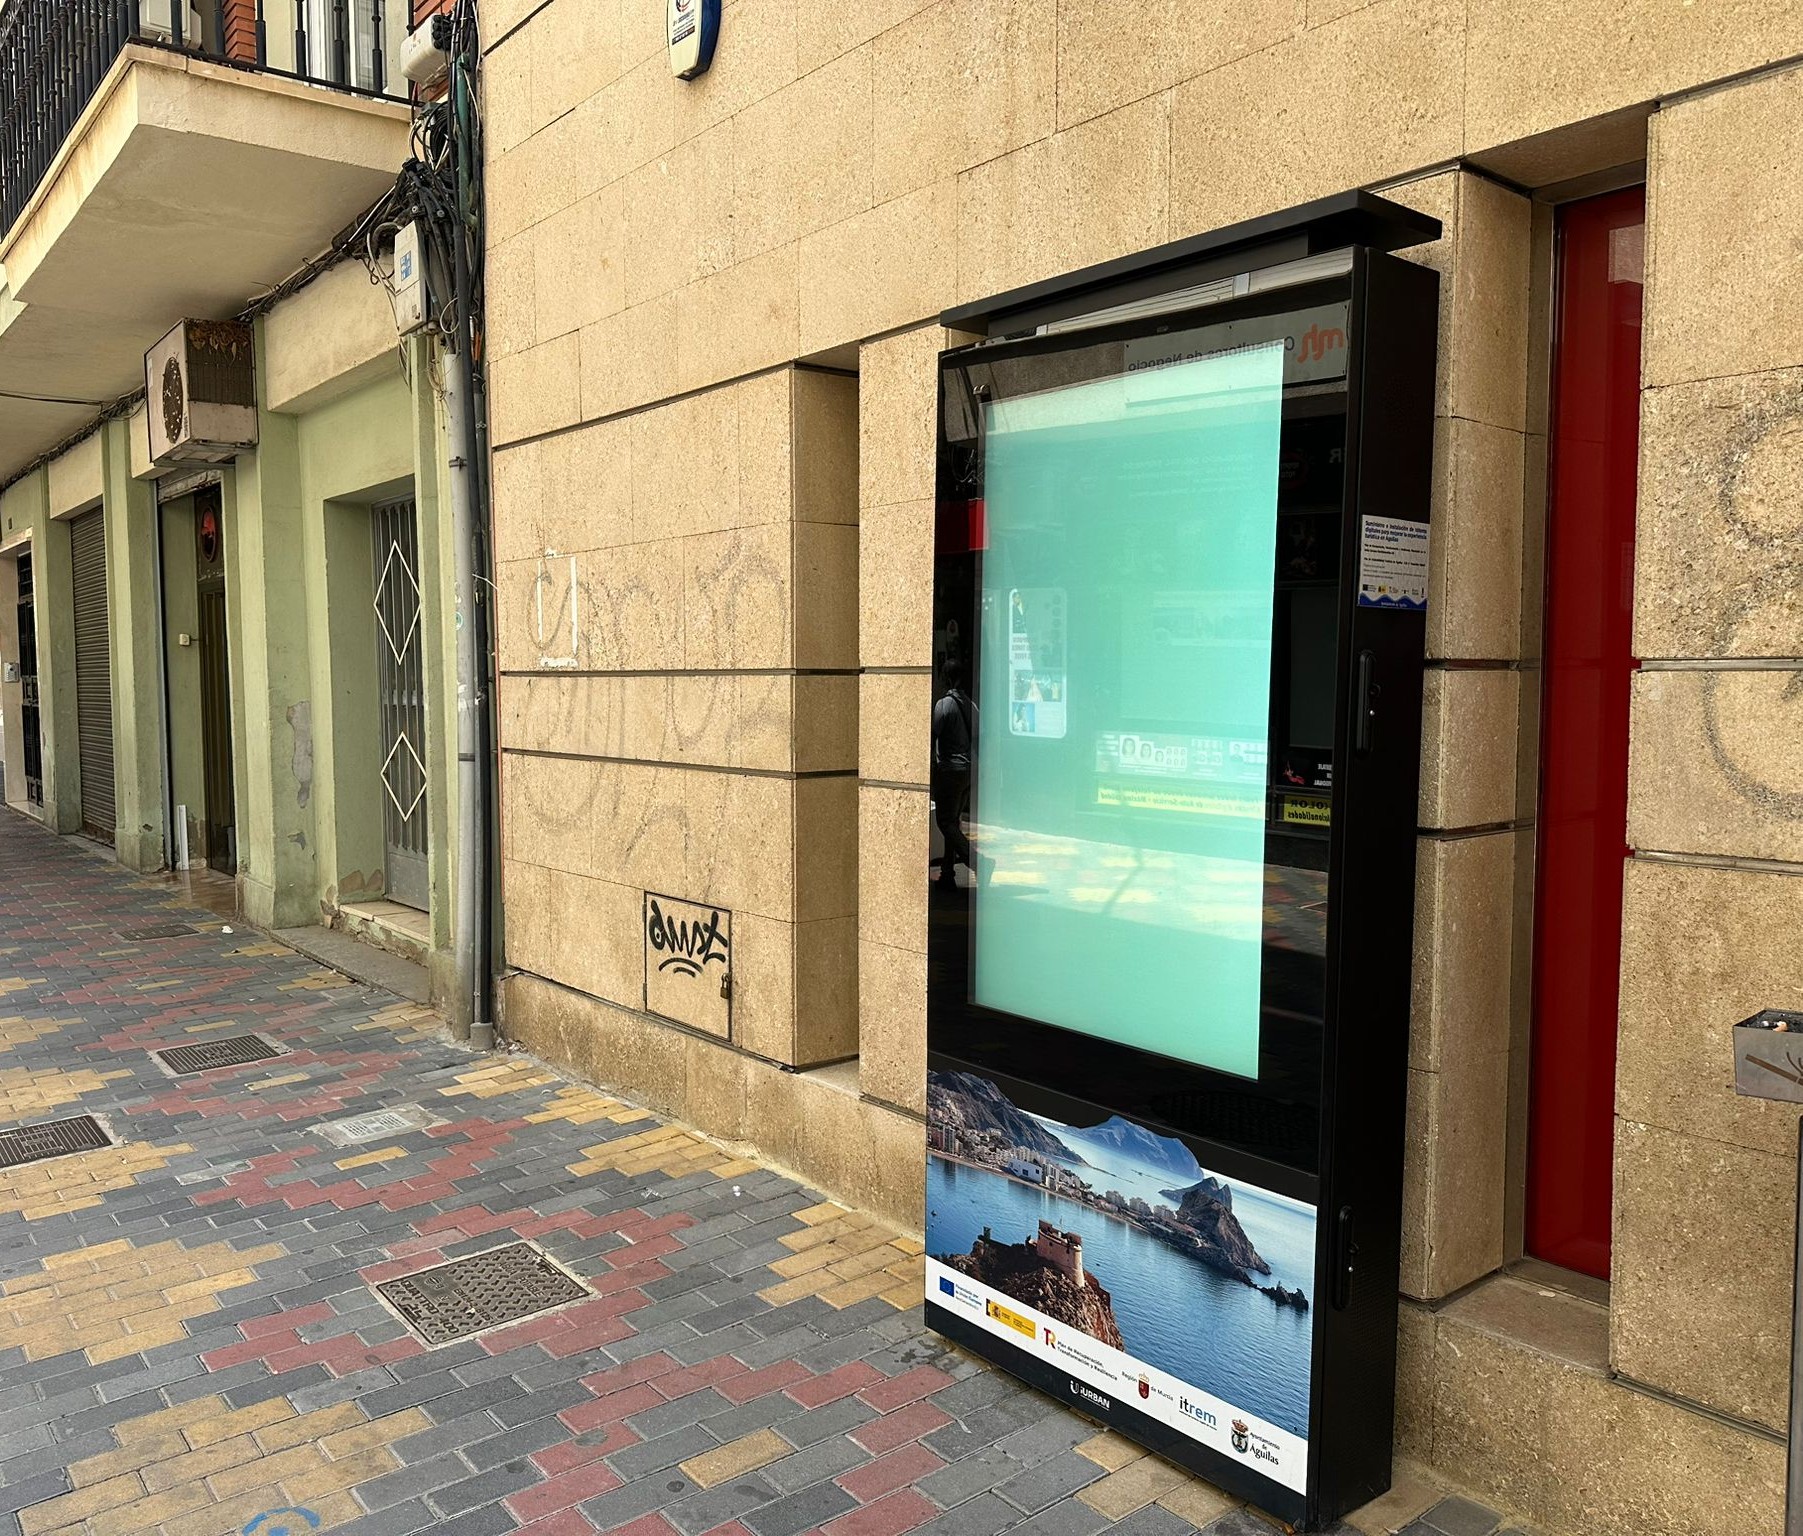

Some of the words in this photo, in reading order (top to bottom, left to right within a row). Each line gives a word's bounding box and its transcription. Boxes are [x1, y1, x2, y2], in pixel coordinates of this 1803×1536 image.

[1121, 1370, 1138, 1383] Región
[1157, 1389, 1174, 1401] Murcia
[1179, 1395, 1217, 1426] itrem
[1249, 1431, 1281, 1451] Ayuntamiento
[1249, 1443, 1279, 1466] Águilas
